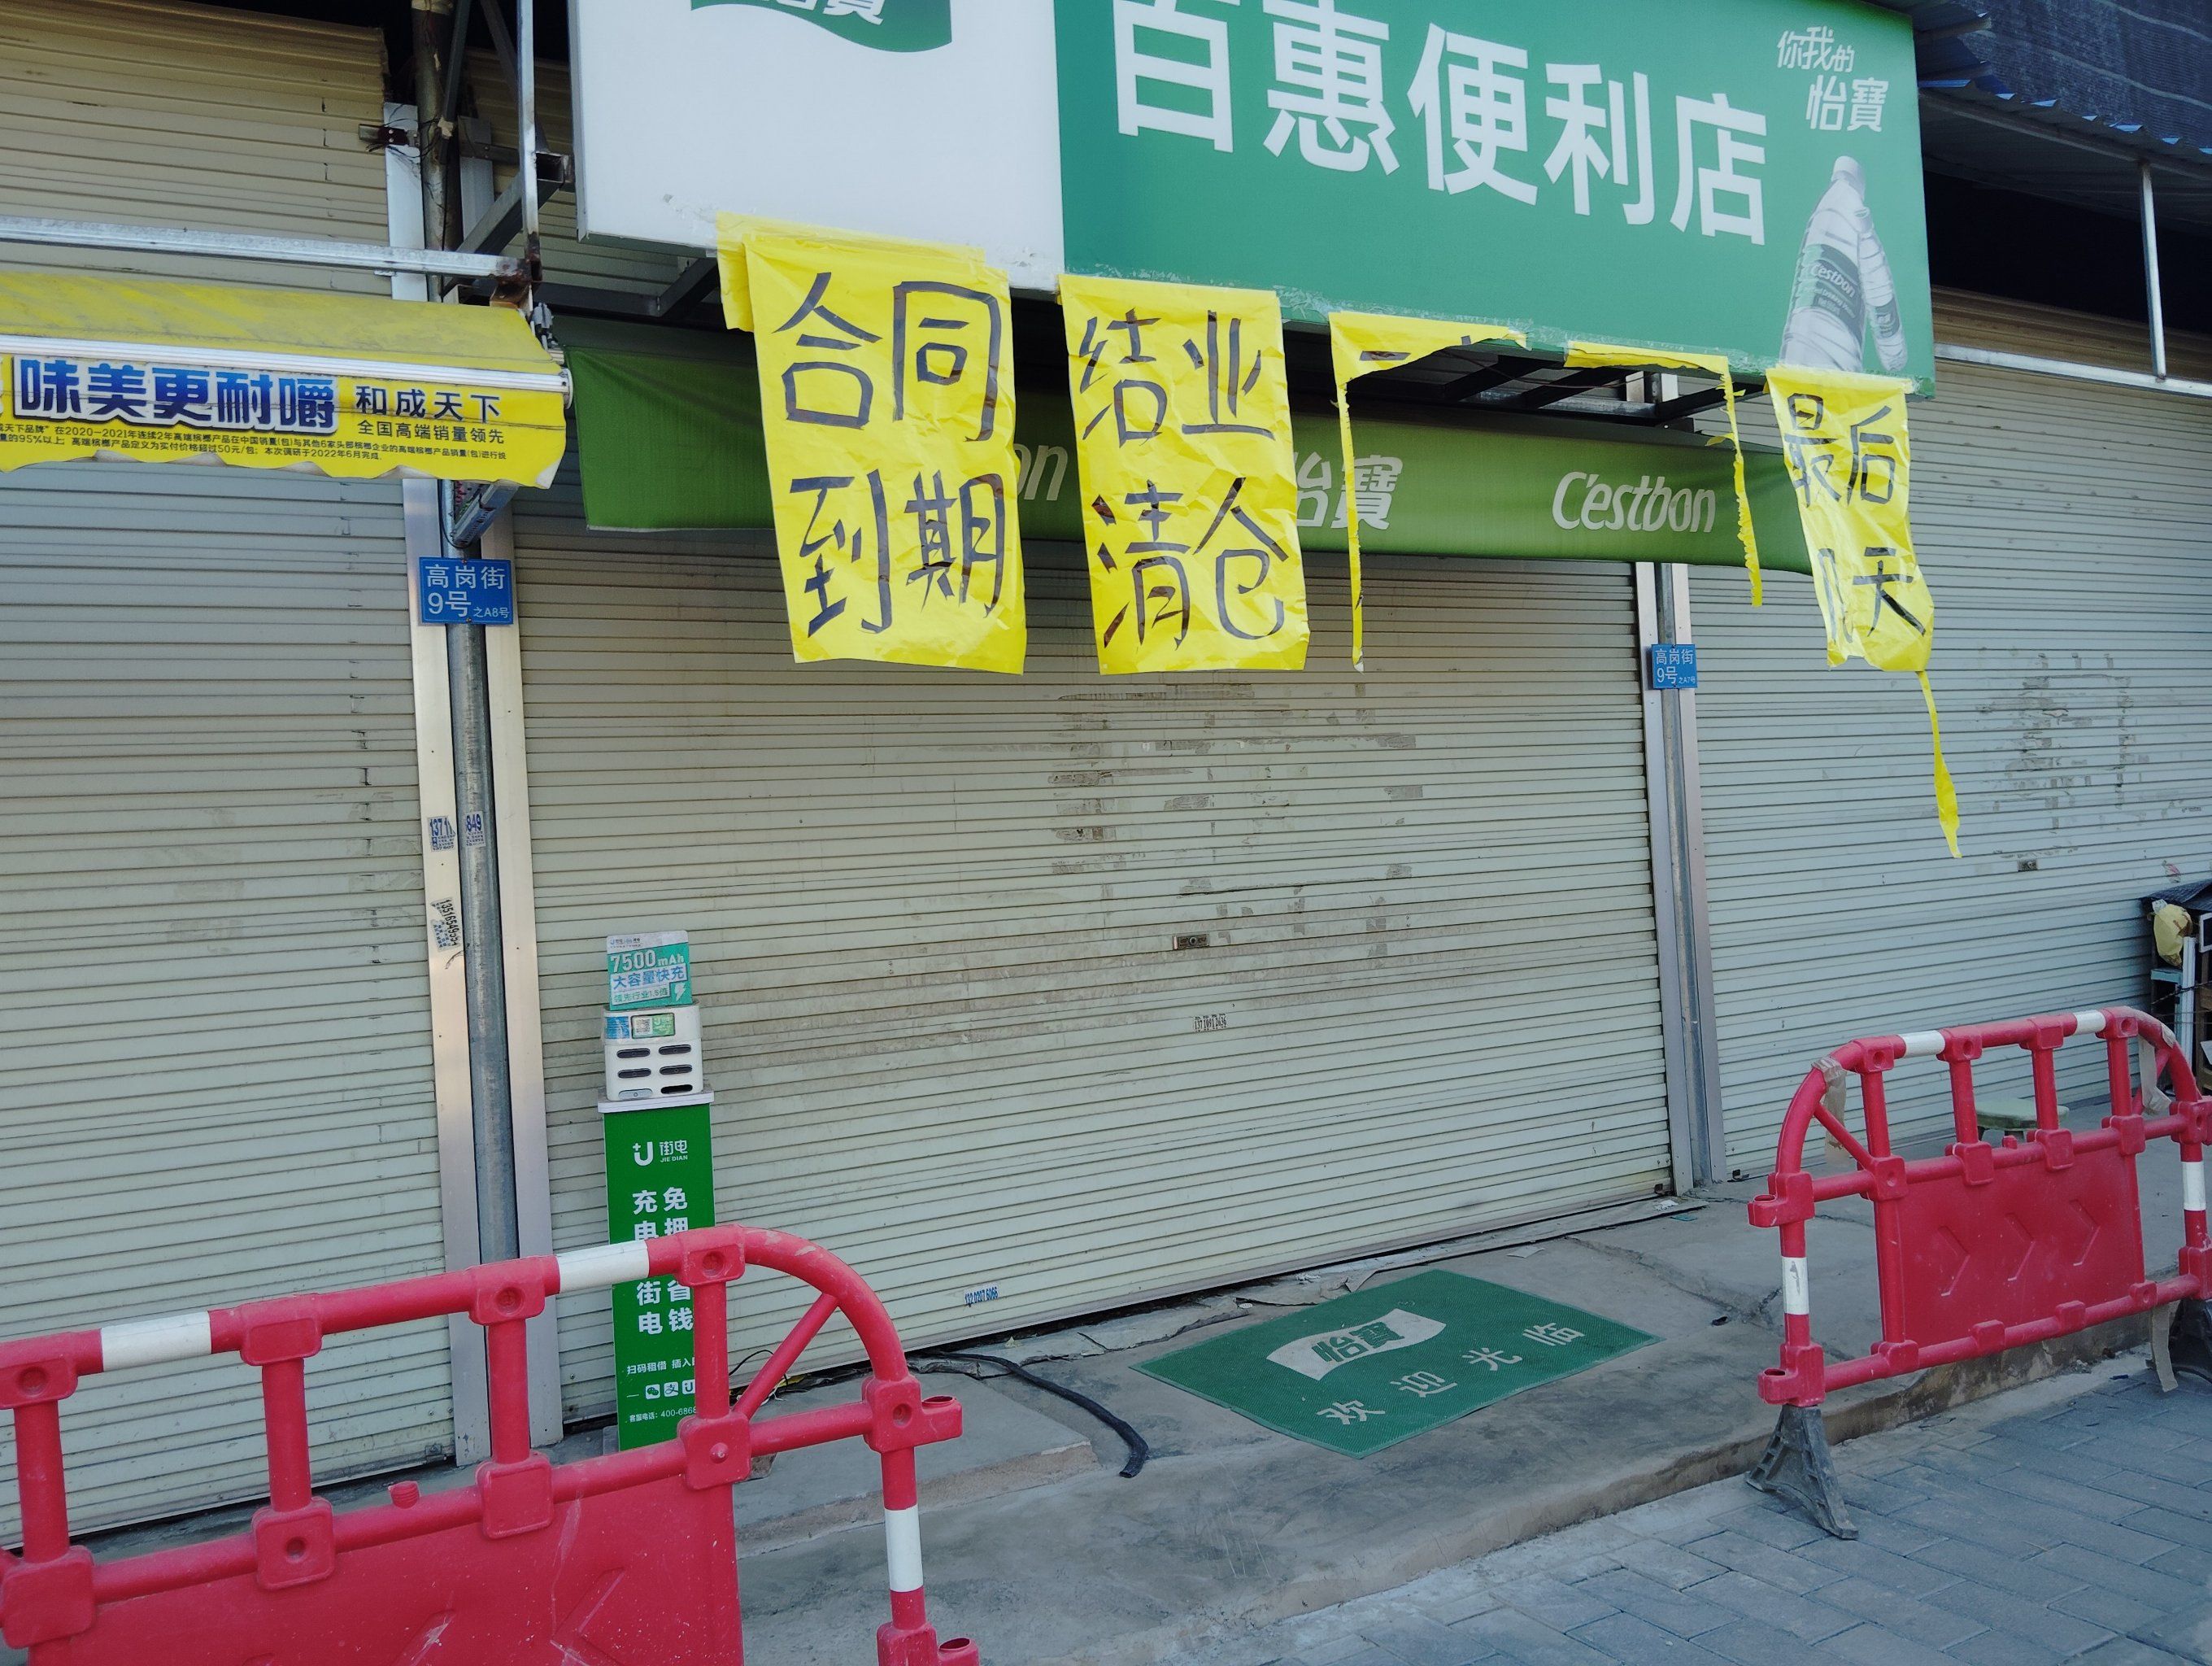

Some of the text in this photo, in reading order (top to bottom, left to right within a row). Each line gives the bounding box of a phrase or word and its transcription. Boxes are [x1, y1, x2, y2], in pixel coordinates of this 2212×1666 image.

[1777, 25, 1855, 72] 你我的
[1113, 0, 1767, 245] 百惠便利店
[1805, 74, 1889, 133] 怡寶
[773, 272, 1001, 441] 合同
[1080, 308, 1274, 447] 结业
[20, 359, 336, 428] 味美更耐嚼
[355, 386, 500, 424] 和成天下
[358, 419, 504, 444] 全国高端销量领先
[1784, 393, 1896, 508] 最后
[1552, 471, 1716, 533] C'estbon
[790, 469, 1004, 637] 到期
[1091, 477, 1288, 649] 清仓
[425, 564, 505, 589] 高岗街
[428, 591, 510, 618] 9号 之A8号
[1655, 648, 1693, 665] 高岗街
[1657, 666, 1678, 683] 9号
[610, 949, 685, 973] 7500mAh
[613, 966, 684, 990] 大容量快充
[660, 1140, 688, 1156] 街电
[1312, 1321, 1405, 1364] 怡寶
[627, 1357, 695, 1376] 扫码租借 插入
[1316, 1322, 1586, 1426] 欢迎光临
